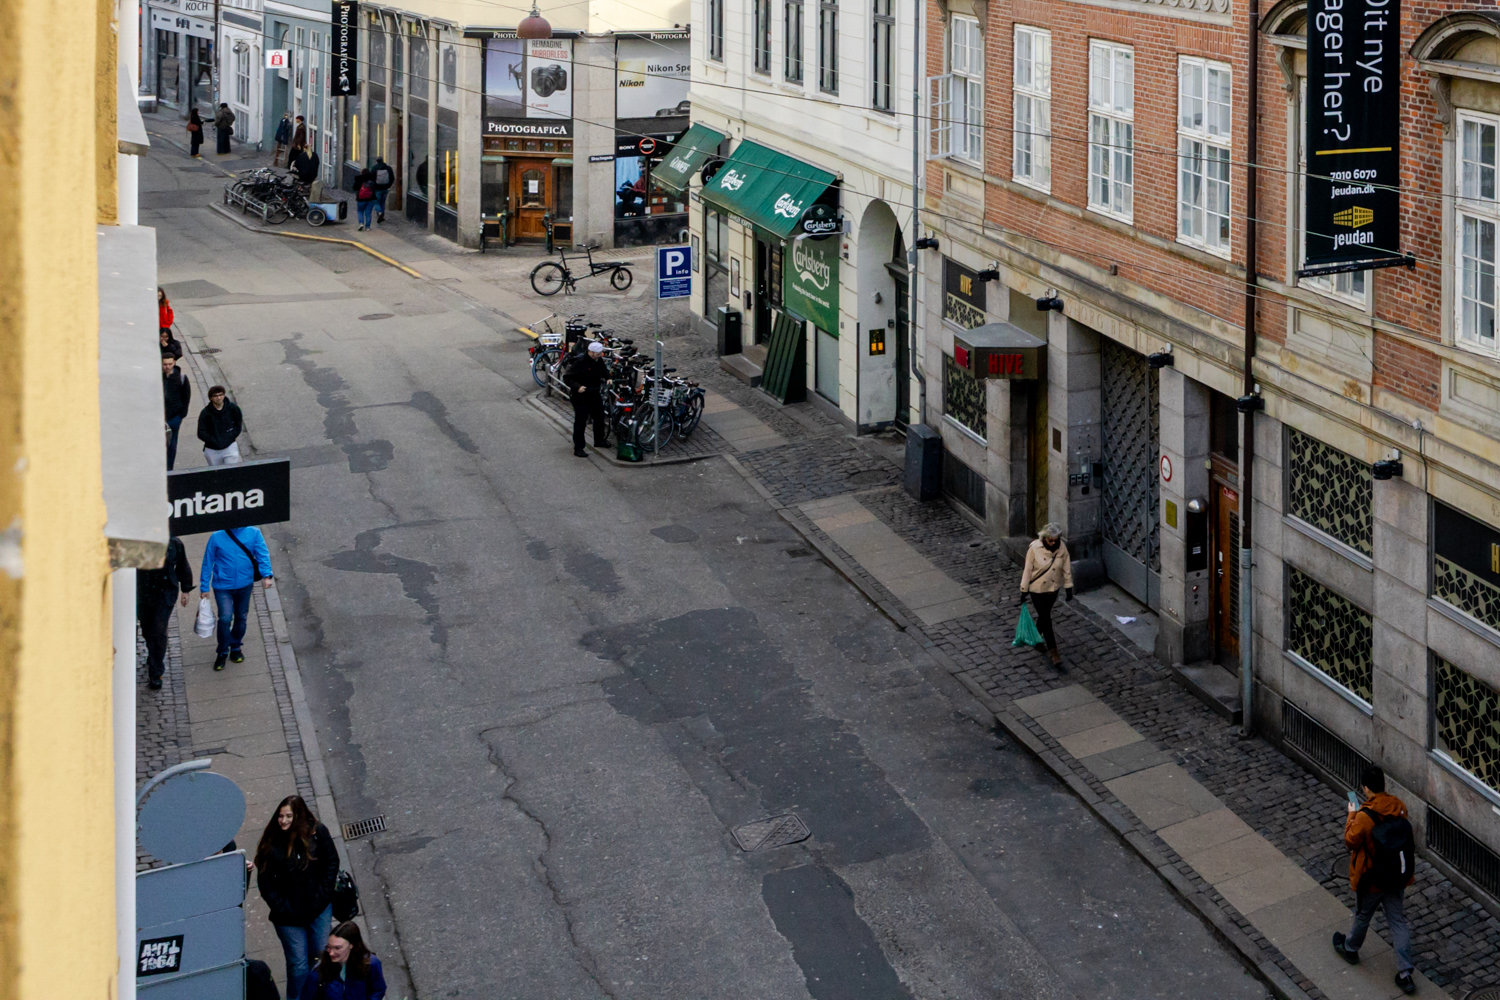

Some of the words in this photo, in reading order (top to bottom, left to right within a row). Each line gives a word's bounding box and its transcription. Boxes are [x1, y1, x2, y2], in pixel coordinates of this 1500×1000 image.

[185, 2, 208, 11] KOCH
[531, 39, 563, 49] REIMAGINE
[531, 49, 569, 59] MIRRORLESS
[647, 64, 674, 73] Nikon
[1356, 39, 1384, 93] nye
[619, 80, 644, 88] Nikon
[1323, 72, 1351, 142] her?
[488, 122, 568, 135] PHOTOGRAFICA
[1330, 171, 1352, 182] 7010
[1353, 169, 1377, 180] 6070
[1331, 184, 1376, 199] jeudan.dk
[774, 193, 802, 218] Carlsberg
[804, 219, 837, 233] Carlsberg
[1333, 229, 1374, 251] jeudan
[666, 251, 685, 275] P
[793, 236, 830, 290] Carlsberg
[988, 353, 1024, 375] HIVE
[168, 488, 264, 518] ntana
